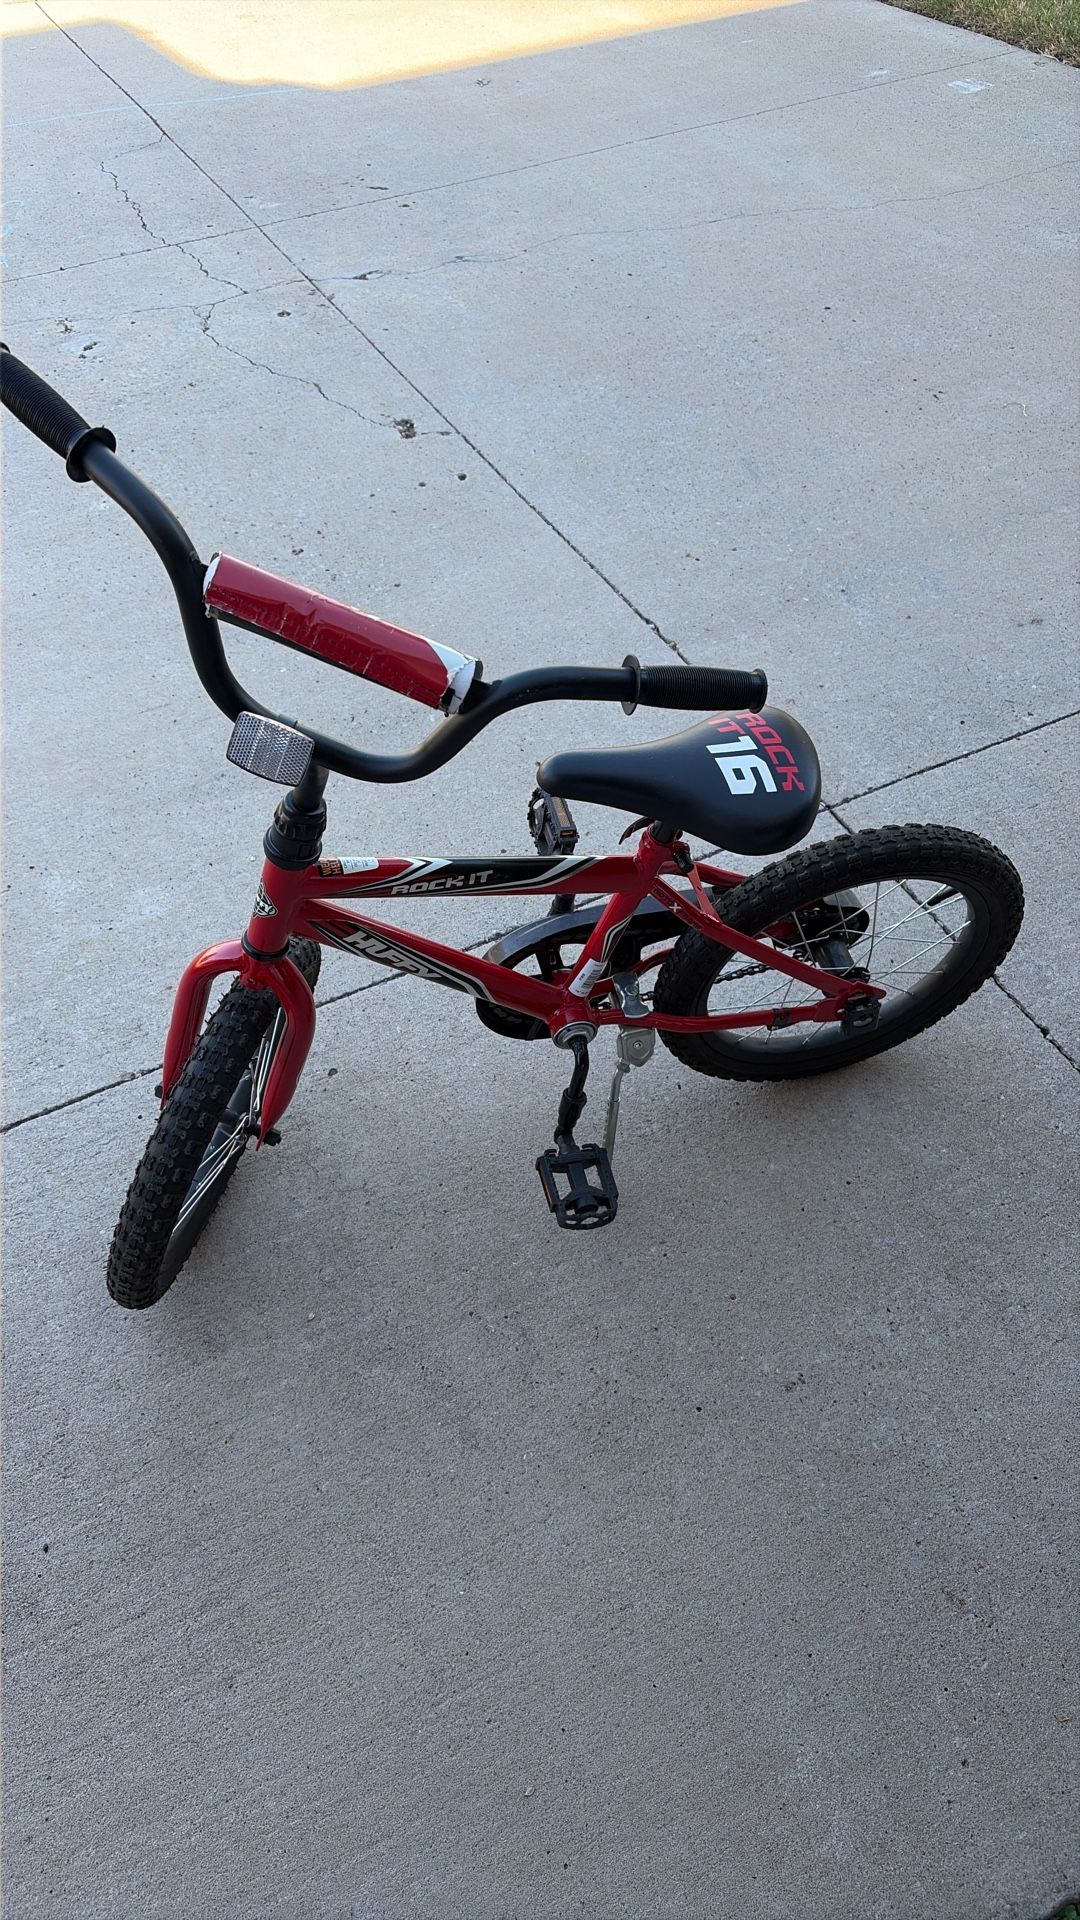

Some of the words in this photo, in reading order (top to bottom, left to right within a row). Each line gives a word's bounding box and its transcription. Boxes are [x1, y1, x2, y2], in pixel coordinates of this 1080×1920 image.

[708, 717, 747, 735] IT
[706, 735, 778, 795] 16
[735, 712, 805, 791] ROCK
[391, 876, 464, 895] ROCK
[468, 870, 494, 884] IT
[343, 930, 443, 978] HUFFY
